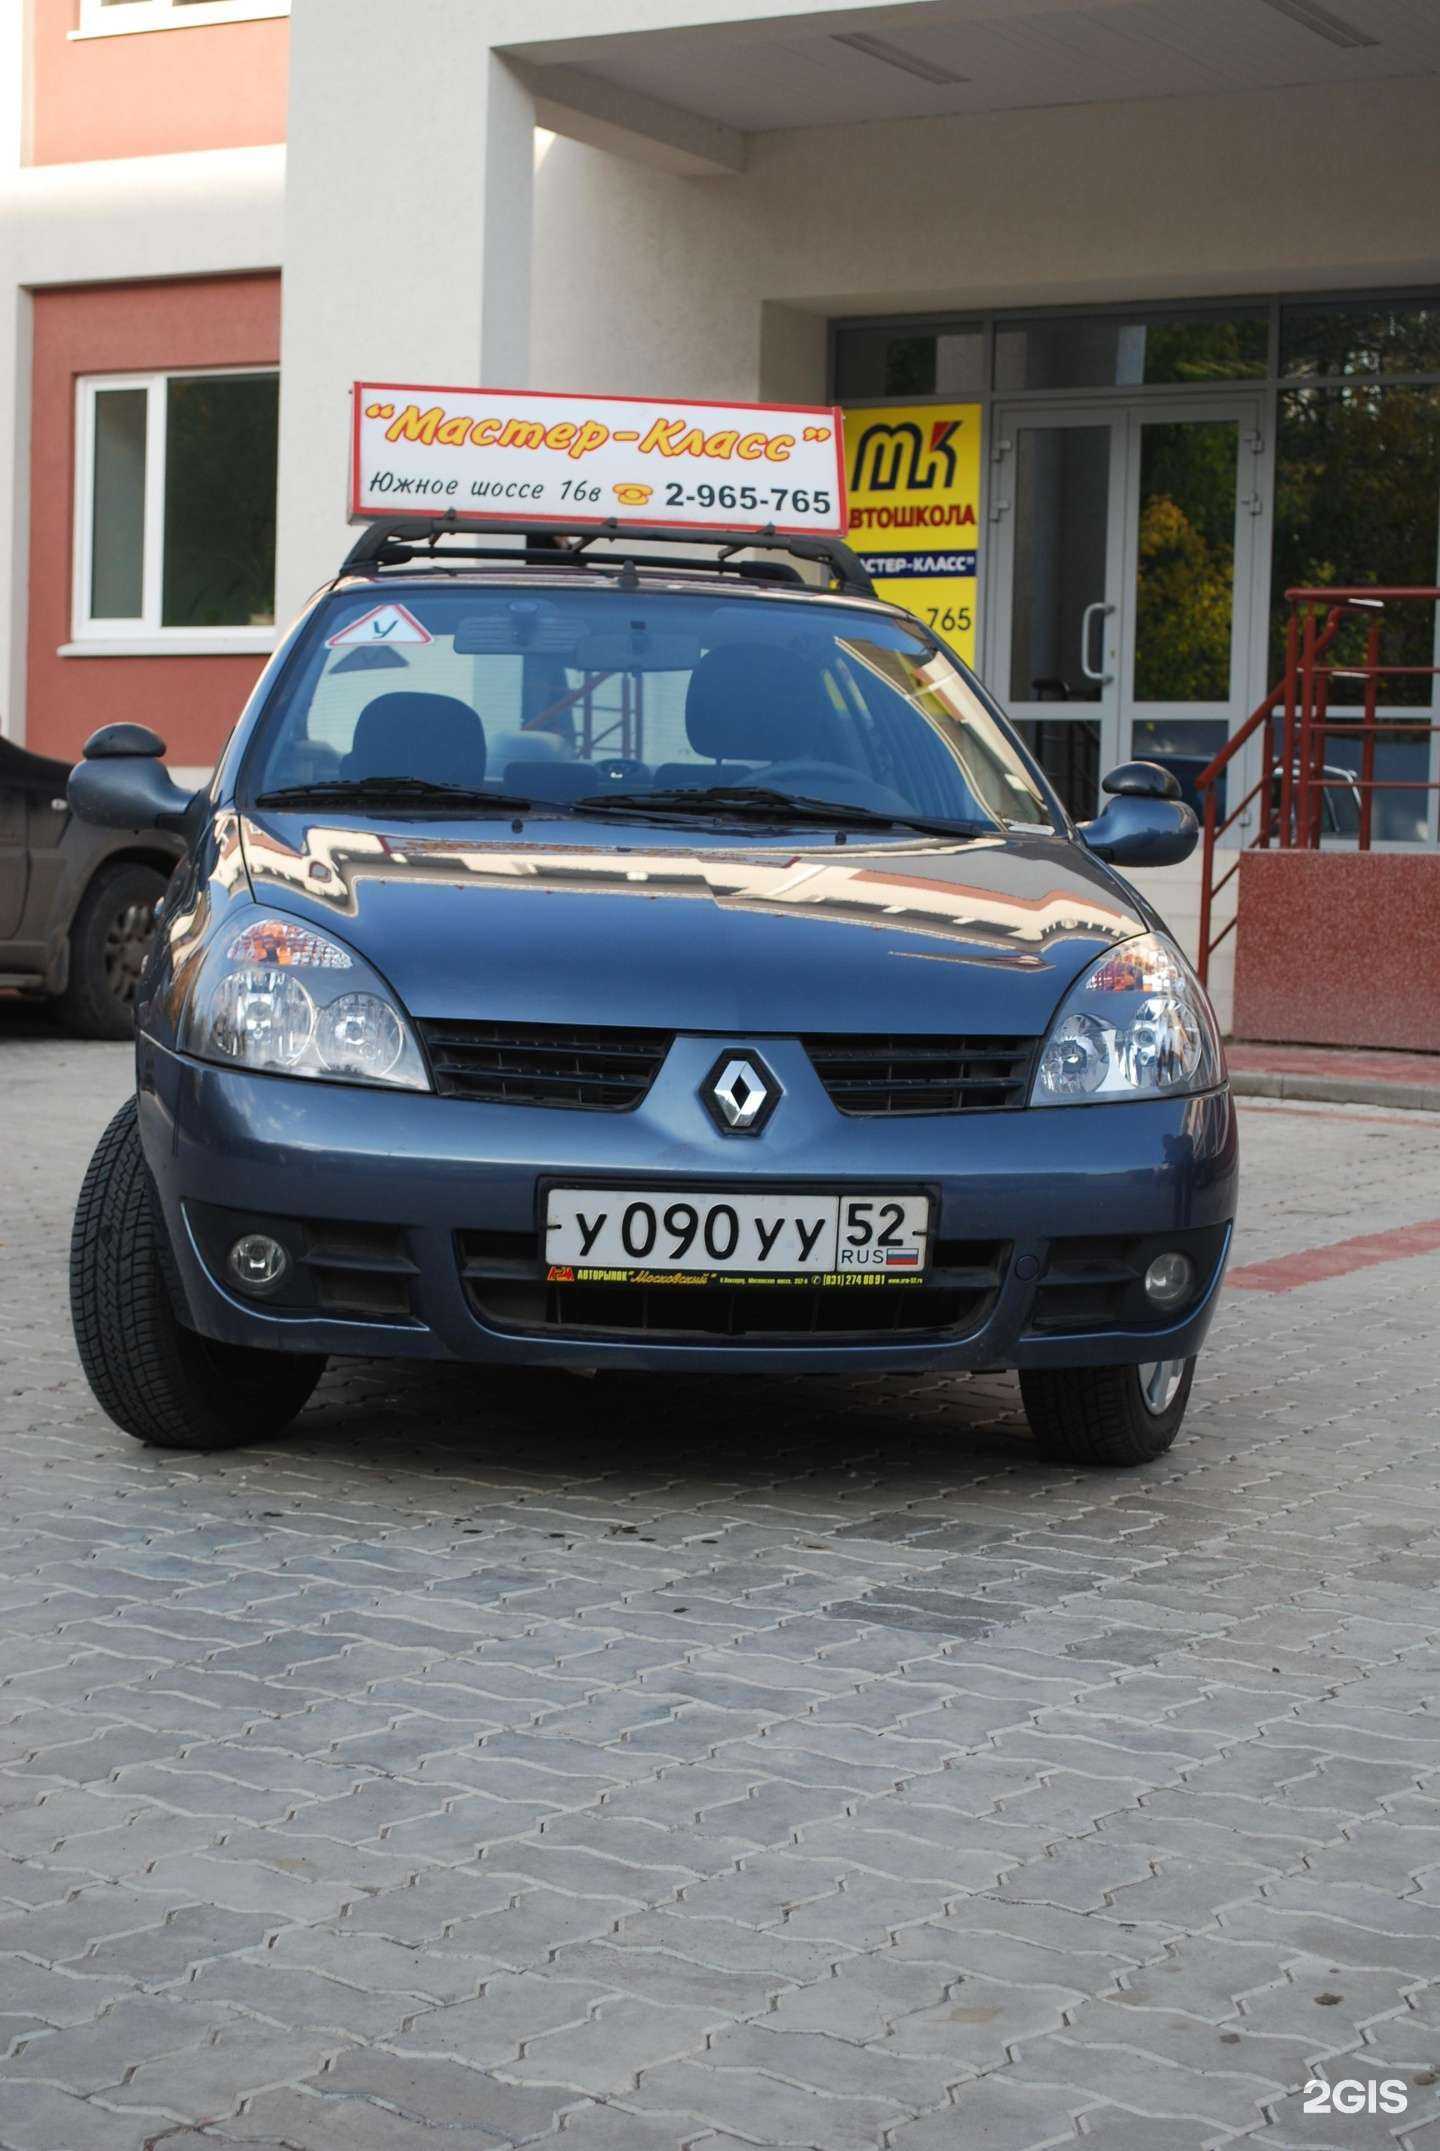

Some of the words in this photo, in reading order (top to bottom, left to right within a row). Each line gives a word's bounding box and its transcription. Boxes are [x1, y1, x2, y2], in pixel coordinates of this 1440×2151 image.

[369, 471, 459, 496] Южное
[470, 479, 544, 500] шоссе
[560, 480, 602, 502] 16в
[665, 482, 832, 514] 2-965-765
[849, 504, 976, 529] ВТОШКОЛА
[862, 556, 975, 573] СТЕР-КЛАСС"
[926, 608, 972, 631] 765
[846, 1203, 906, 1247] 52
[841, 1249, 884, 1264] RUS
